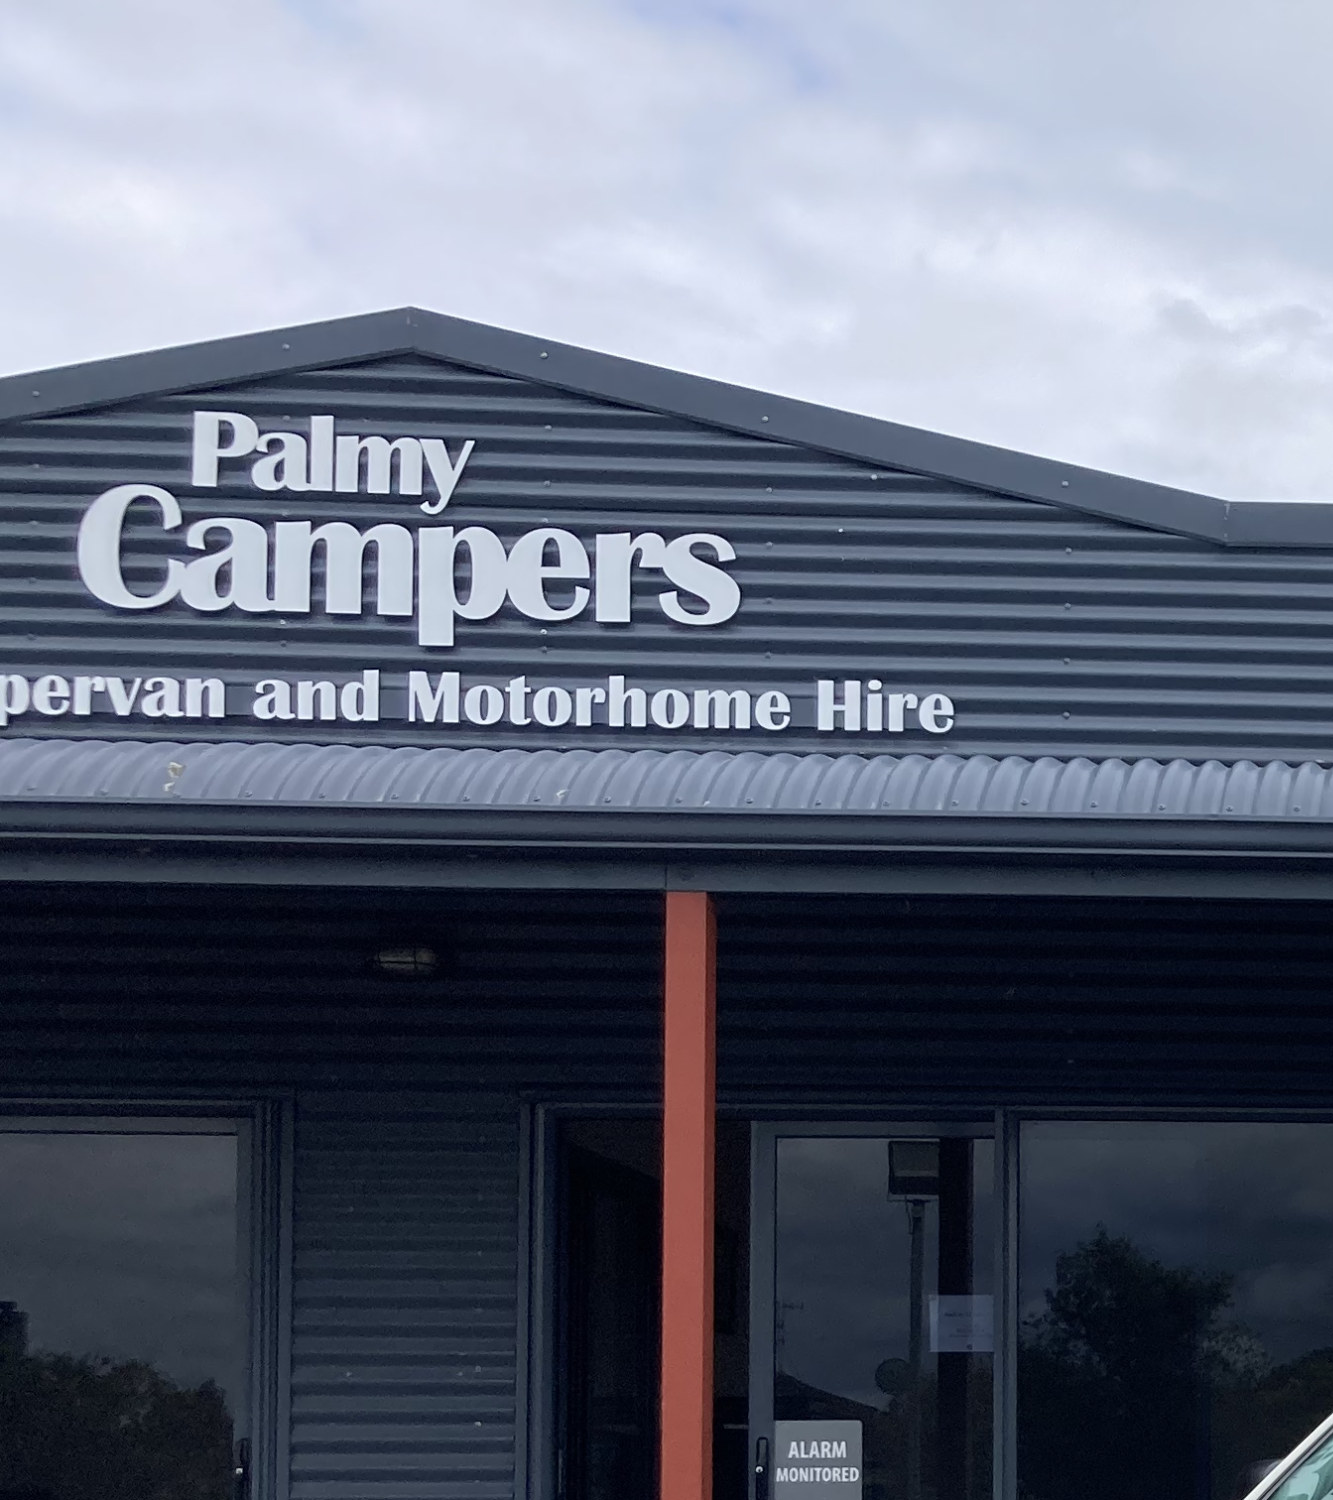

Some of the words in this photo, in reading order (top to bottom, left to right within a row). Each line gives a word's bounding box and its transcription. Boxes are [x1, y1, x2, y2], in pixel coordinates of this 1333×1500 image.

[192, 411, 475, 514] Palmy
[77, 484, 741, 646] Campers
[252, 669, 380, 721] and
[408, 670, 791, 731] Motorhome
[817, 679, 955, 733] Hire
[776, 1467, 860, 1482] MONITORED
[788, 1441, 847, 1459] ALARM
